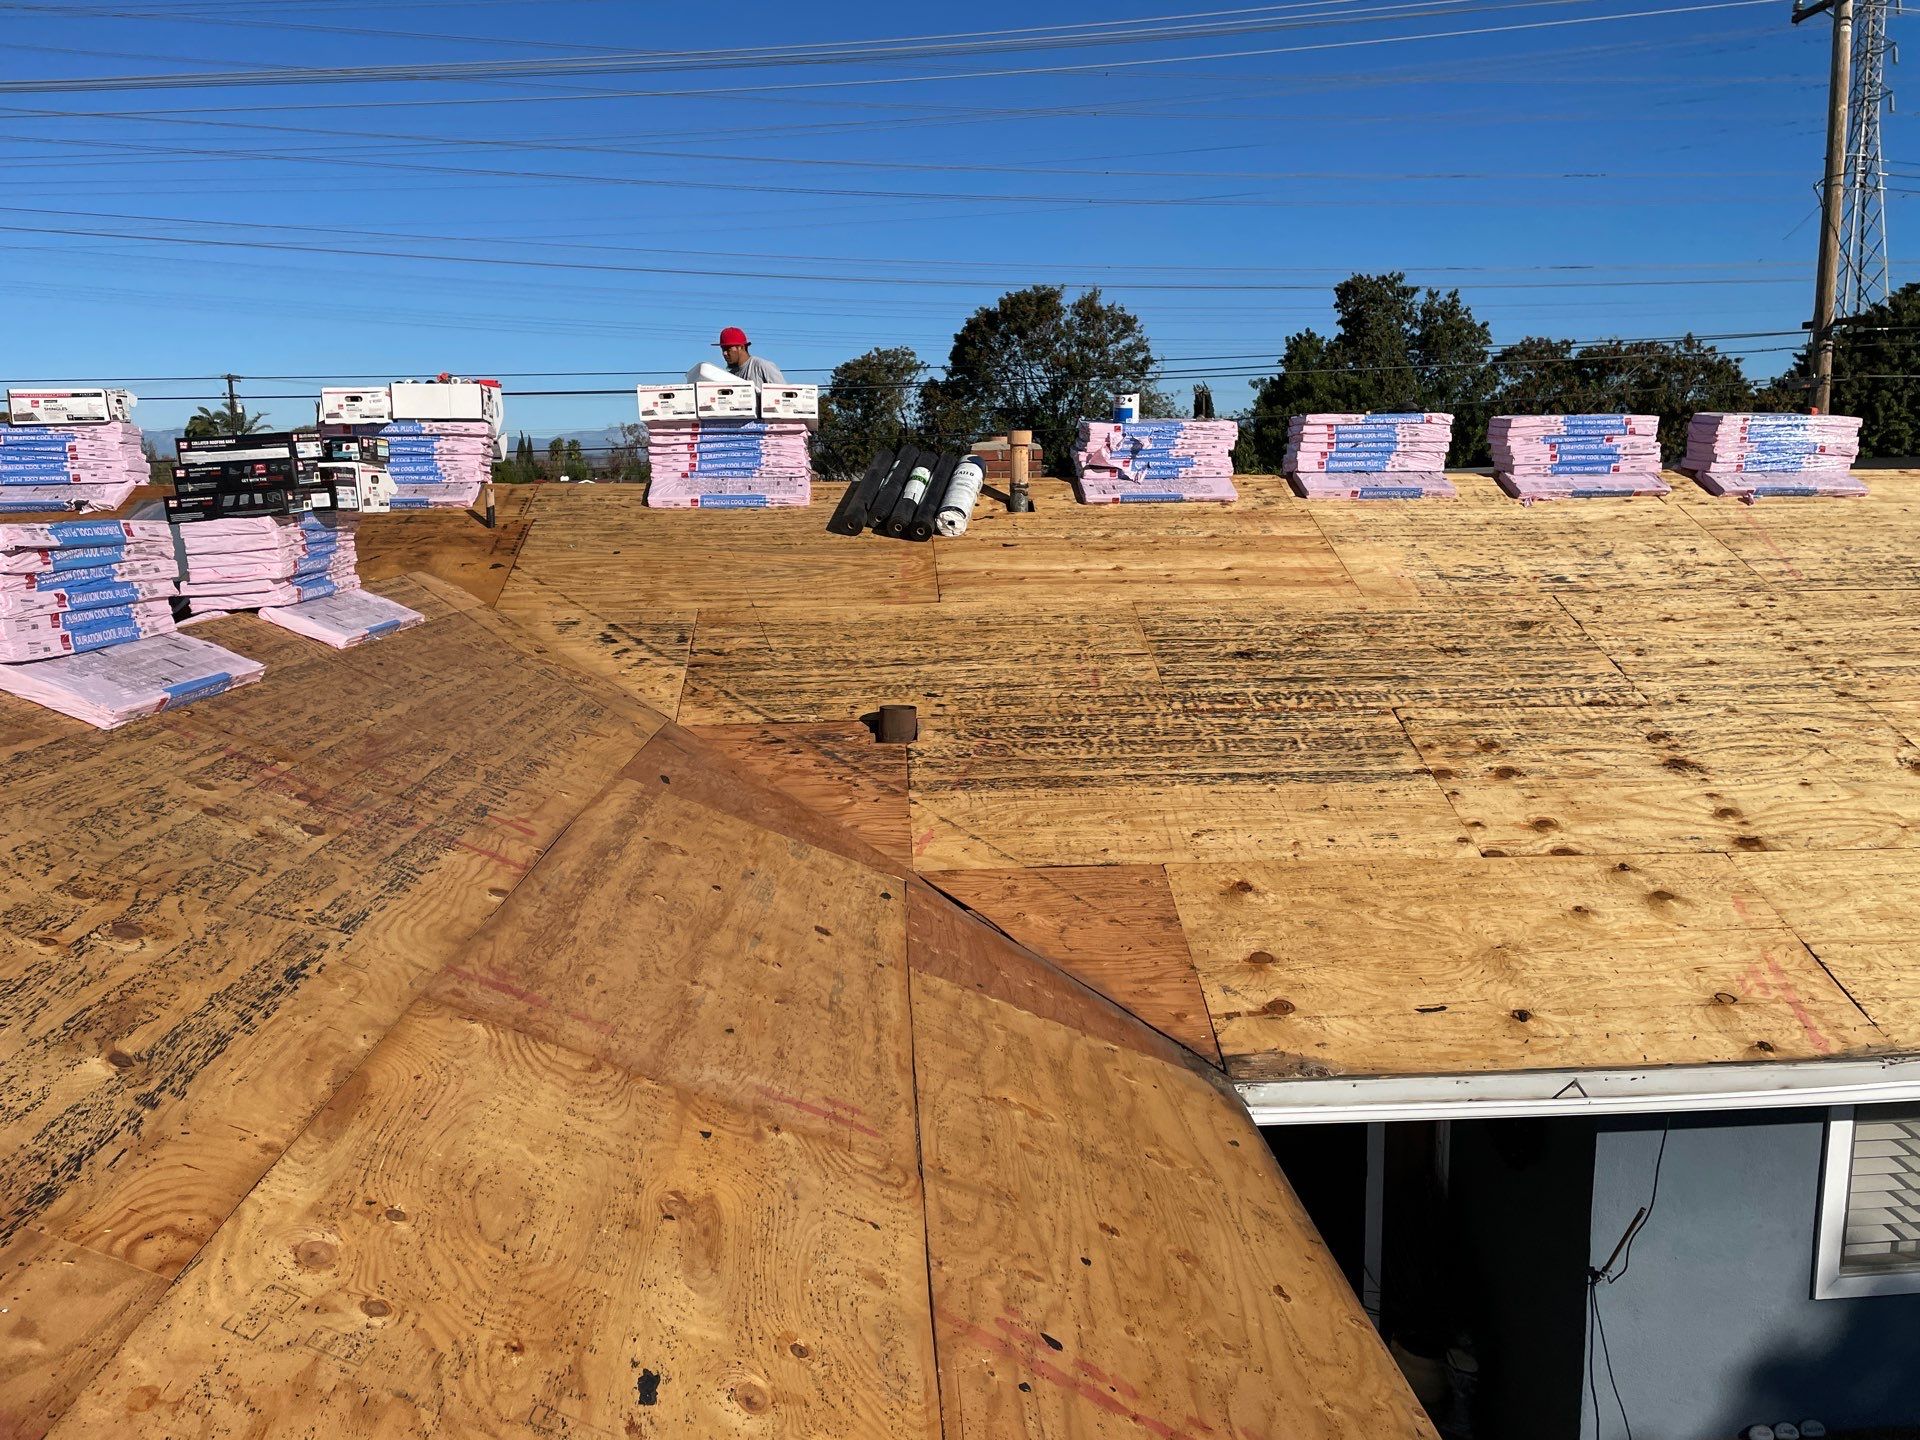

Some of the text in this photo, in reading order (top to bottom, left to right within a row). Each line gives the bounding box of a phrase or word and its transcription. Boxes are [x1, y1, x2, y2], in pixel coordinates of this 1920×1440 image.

[384, 426, 400, 434] COOL
[400, 425, 414, 434] PLUS
[71, 588, 128, 604] DURATION COOL PLUS
[65, 608, 123, 624] DURATION COOL PLUS
[75, 627, 132, 645] DURATION COOL PLUS
